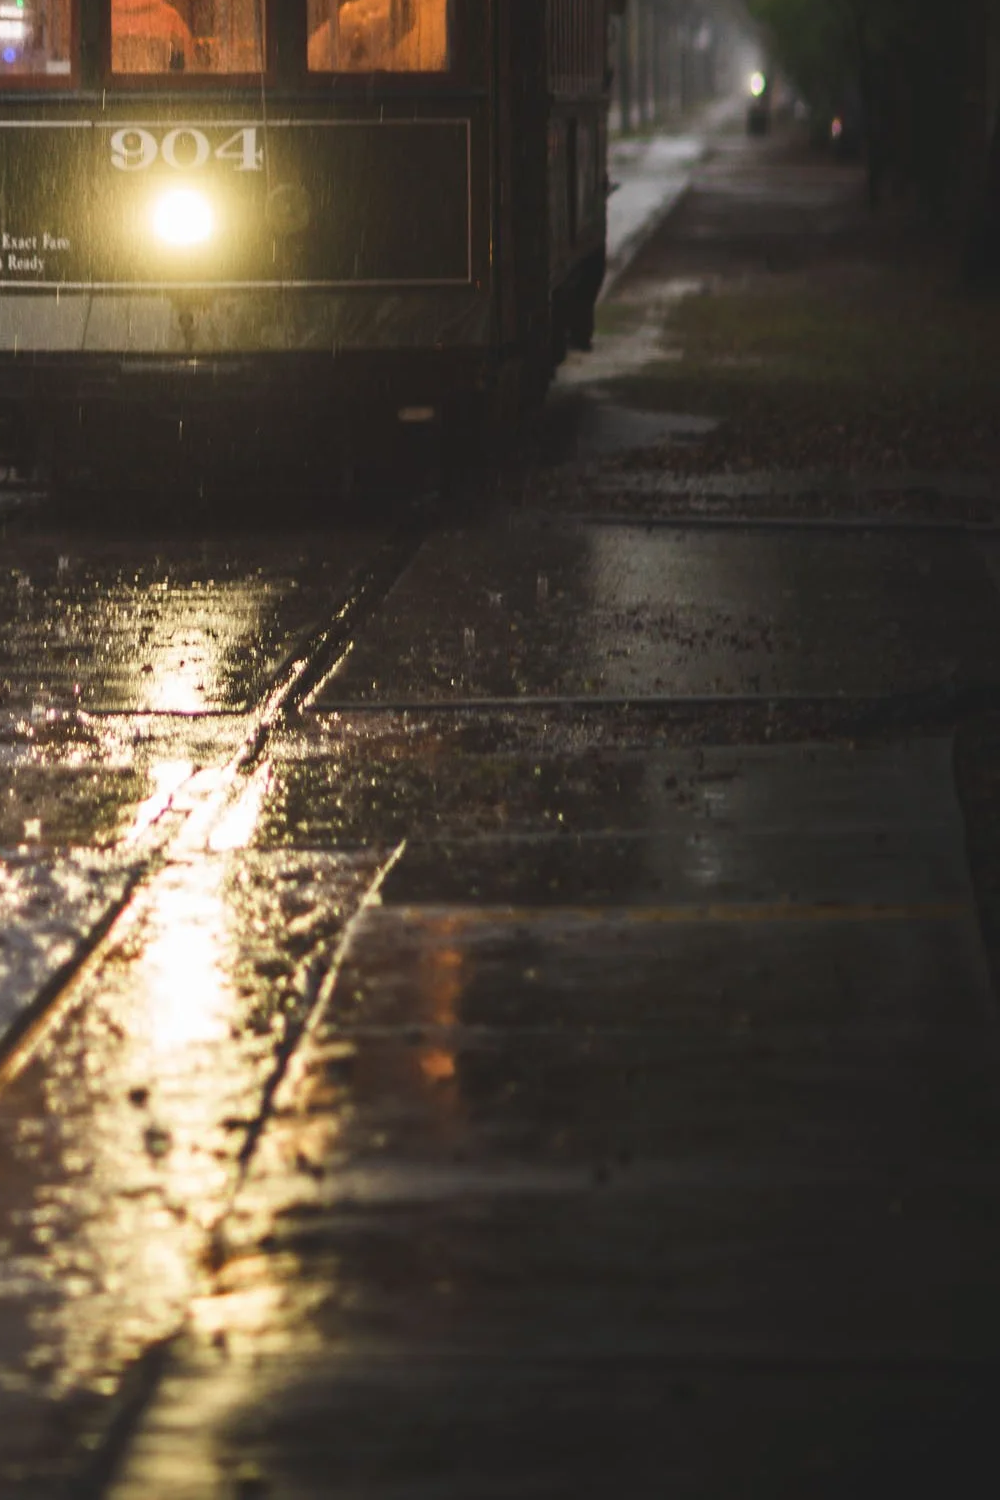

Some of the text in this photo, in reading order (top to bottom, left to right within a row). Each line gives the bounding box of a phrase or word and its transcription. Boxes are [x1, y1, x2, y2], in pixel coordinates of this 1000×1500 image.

[110, 127, 263, 172] 904
[2, 232, 37, 250] Exact
[8, 254, 45, 273] Ready
